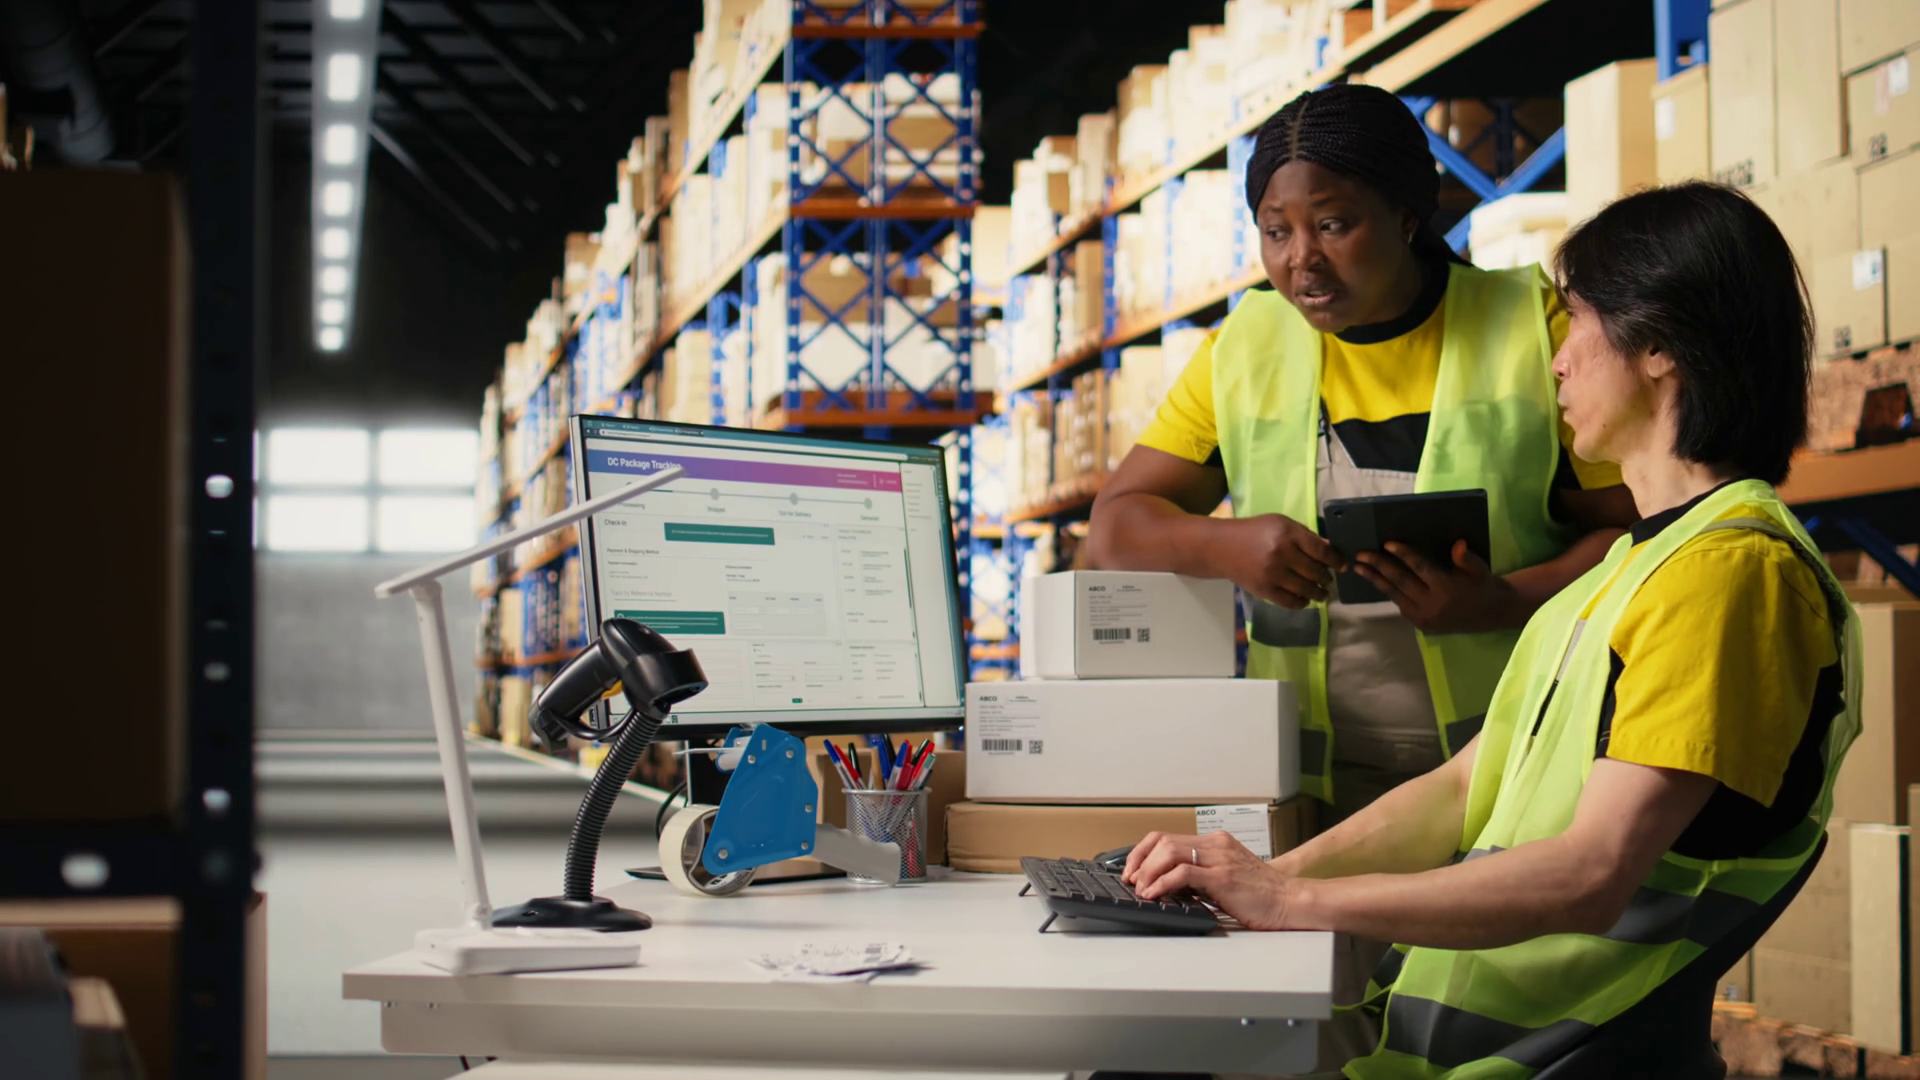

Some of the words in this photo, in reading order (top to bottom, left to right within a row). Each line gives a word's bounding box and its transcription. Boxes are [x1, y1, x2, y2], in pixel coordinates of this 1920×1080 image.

[607, 457, 620, 467] DC
[620, 458, 651, 471] Package
[1196, 808, 1217, 817] ABCO
